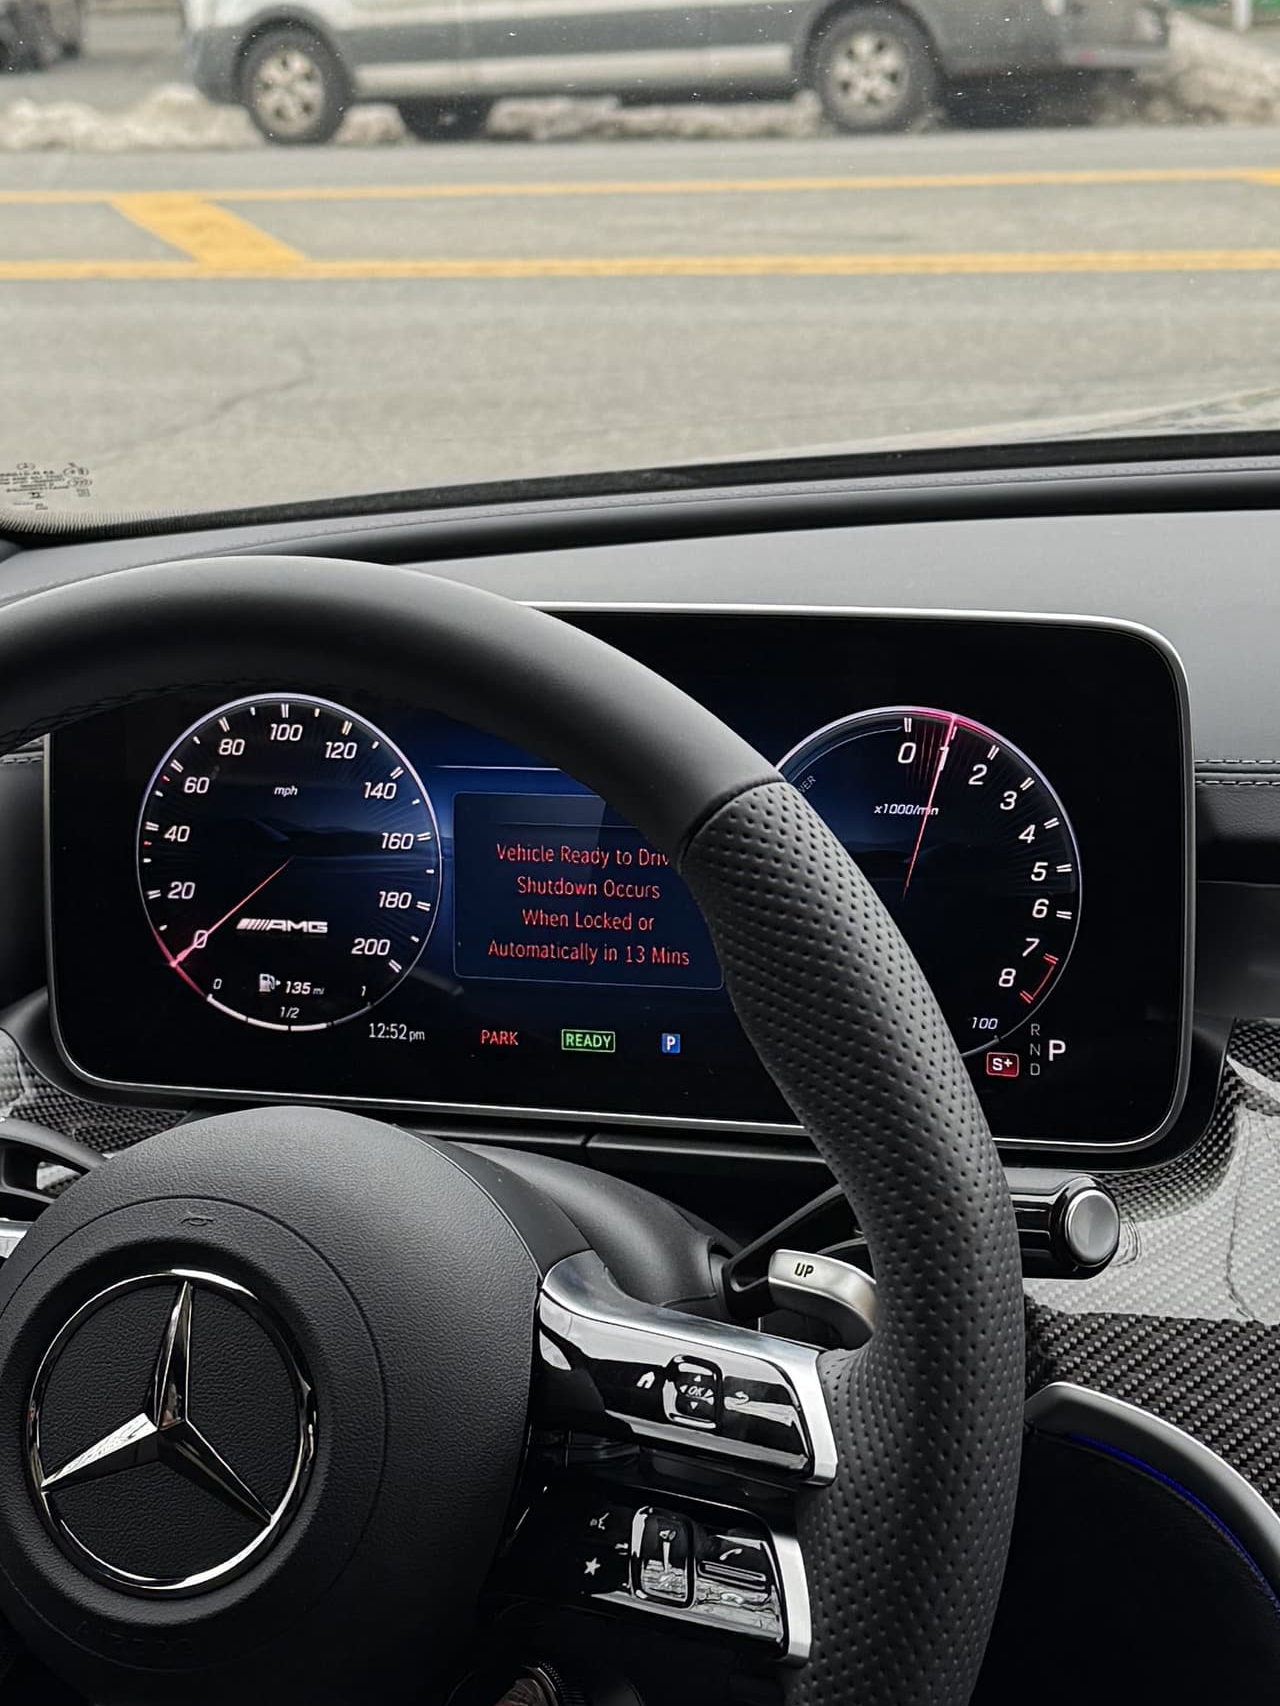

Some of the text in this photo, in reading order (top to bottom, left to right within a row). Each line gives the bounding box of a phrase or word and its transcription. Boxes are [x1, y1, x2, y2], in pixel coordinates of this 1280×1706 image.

[270, 724, 303, 741] 100
[219, 739, 245, 756] 80
[325, 742, 357, 759] 120
[898, 742, 917, 764] 0
[968, 764, 988, 785] 2
[184, 777, 210, 794] 60
[274, 785, 298, 796] mph
[364, 782, 397, 800] 140
[1000, 791, 1018, 810] 3
[164, 826, 190, 843] 40
[381, 833, 414, 850] 160
[1019, 824, 1036, 844] 4
[496, 843, 670, 868] Vehicle Ready to Driv
[1030, 862, 1049, 882] 5
[168, 882, 195, 899] 20
[517, 876, 661, 900] Shutdown Occurs
[378, 891, 412, 909] 180
[1032, 898, 1049, 919] 6
[266, 920, 328, 933] AMG
[522, 909, 655, 932] When Locked or
[194, 930, 207, 948] 0
[351, 938, 390, 956] 200
[1022, 937, 1040, 957] 7
[488, 940, 690, 966] Automatically in 13 Mins
[213, 978, 222, 990] 0
[998, 968, 1016, 988] 8
[285, 982, 311, 994] 135
[280, 1007, 300, 1019] 1/2
[972, 1017, 999, 1030] 100
[1030, 1024, 1040, 1037] R
[481, 1030, 519, 1046] PARK
[565, 1033, 612, 1049] READY
[1030, 1044, 1041, 1056] N
[1048, 1040, 1066, 1062] P
[992, 1057, 1014, 1071] S+
[1030, 1063, 1041, 1076] D
[794, 1263, 815, 1279] UP
